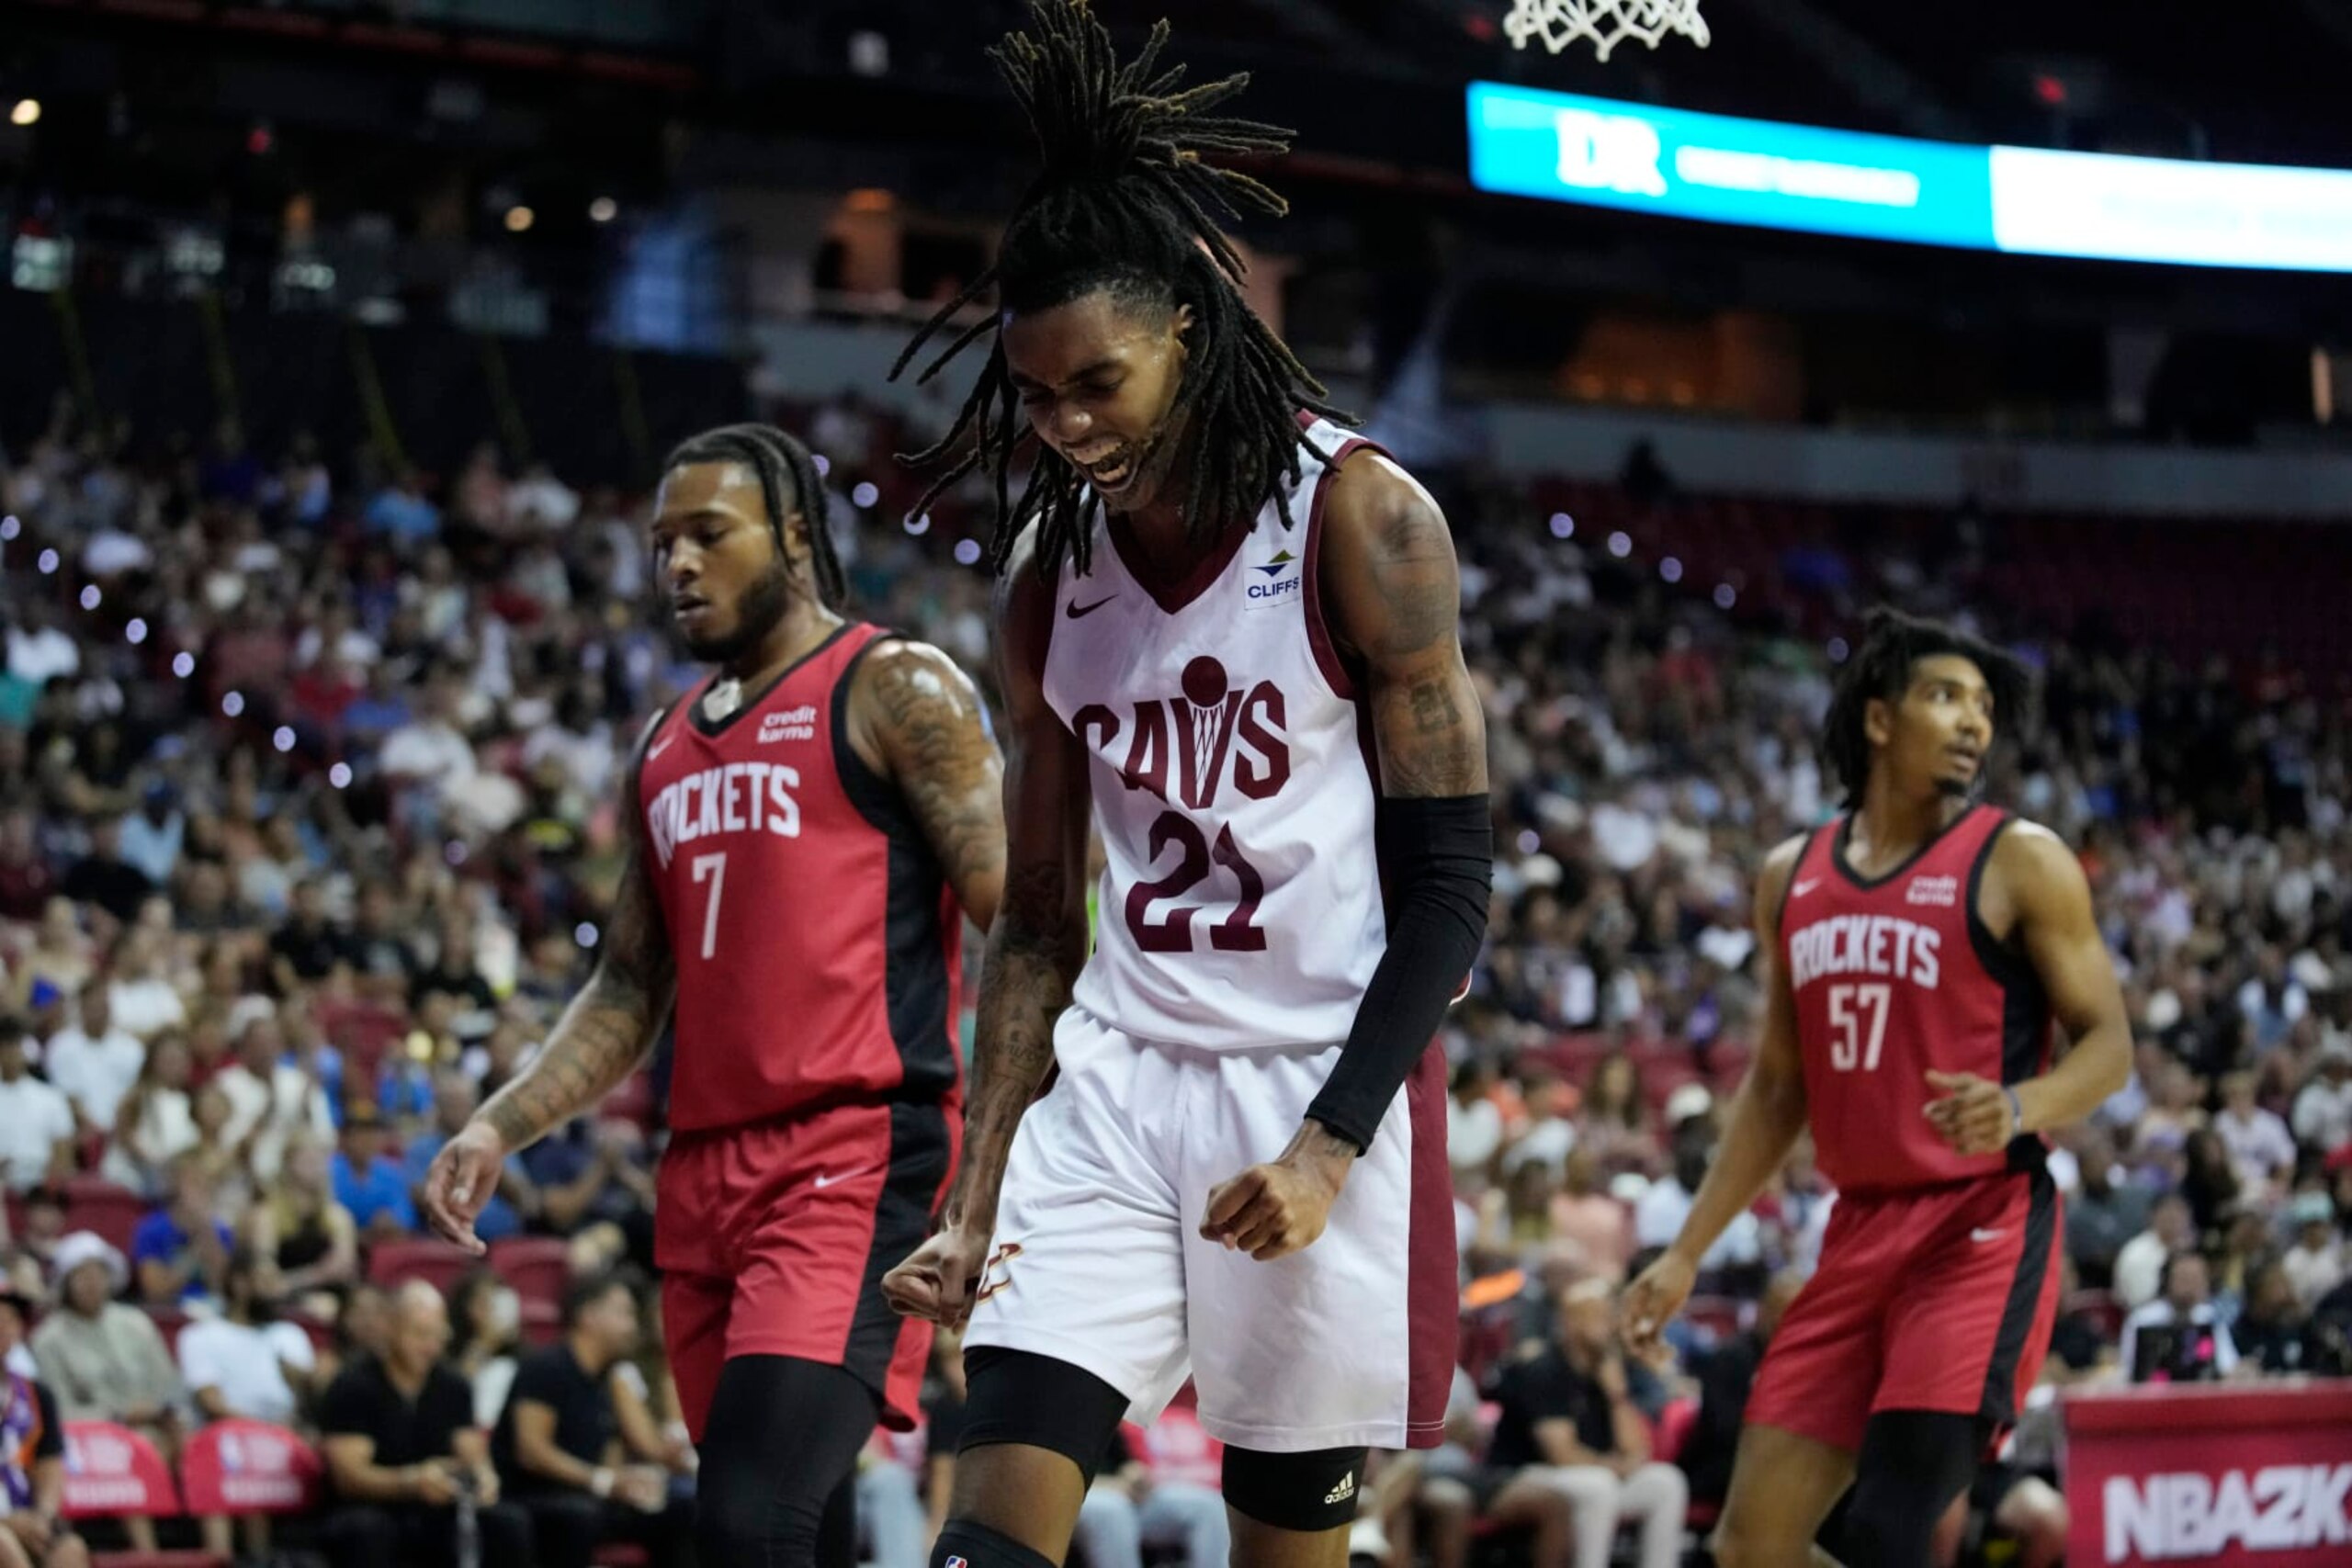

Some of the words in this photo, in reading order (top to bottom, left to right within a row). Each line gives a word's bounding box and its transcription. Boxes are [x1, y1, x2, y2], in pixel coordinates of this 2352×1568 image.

[1248, 577, 1299, 599] CLIFFS
[757, 724, 814, 744] karma
[764, 705, 817, 727] credit
[648, 762, 800, 870] ROCKETS
[693, 852, 727, 960] 7
[1125, 809, 1267, 953] 21
[1790, 915, 1940, 990] ROCKETS
[1828, 983, 1891, 1072] 57
